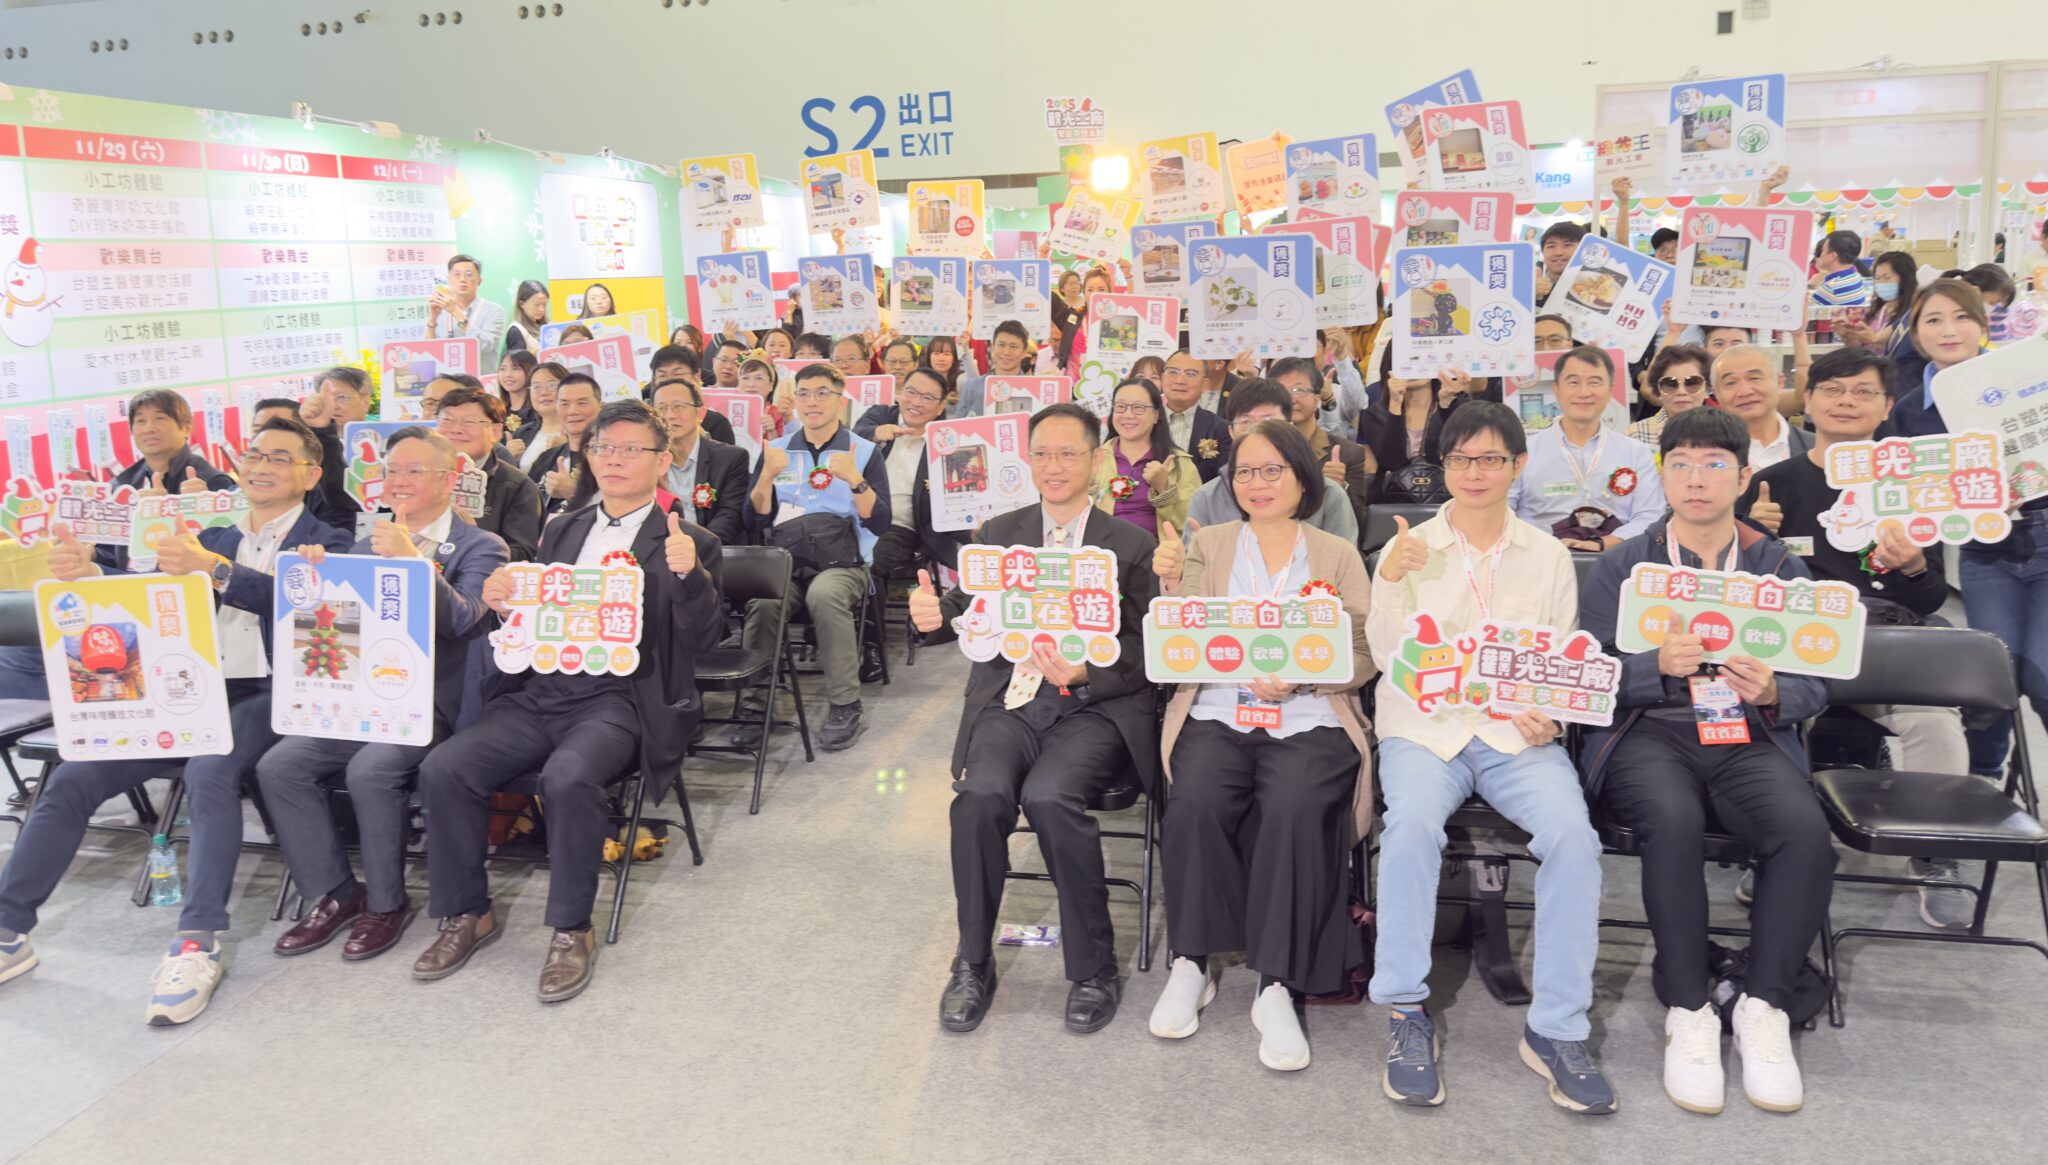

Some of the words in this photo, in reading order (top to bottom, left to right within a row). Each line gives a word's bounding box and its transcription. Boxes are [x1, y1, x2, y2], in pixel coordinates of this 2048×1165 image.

[800, 94, 890, 158] S2
[898, 90, 953, 125] 出口
[75, 137, 127, 159] 11/29
[132, 140, 165, 162] (六)
[900, 131, 954, 158] EXIT
[85, 170, 163, 190] 小工坊體驗
[1535, 171, 1571, 185] Kang
[98, 247, 163, 265] 歡樂舞台
[1488, 255, 1507, 289] 獲獎
[104, 319, 182, 342] 小工坊體驗
[1832, 436, 1997, 483] 觀光工廠
[61, 483, 107, 501] 2025
[1876, 471, 2001, 513] 自在遊
[60, 498, 130, 521] 觀光工
[964, 550, 1111, 591] 觀光工廠
[508, 566, 643, 605] 觀光工廠
[1638, 568, 1852, 618] 觀光工廠自在遊
[536, 603, 638, 642] 自在遊
[1001, 588, 1114, 631] 自在遊
[1155, 600, 1338, 628] 觀光工廠自在遊
[1482, 624, 1551, 653] 2025
[1693, 622, 1730, 641] 體驗
[1744, 628, 1782, 646] 歡樂
[1797, 635, 1835, 652] 美學
[1167, 646, 1195, 660] 教育
[1208, 646, 1241, 661] 體驗
[1253, 646, 1285, 661] 歡樂
[1299, 646, 1329, 660] 美學
[1478, 645, 1616, 693] 觀光工廠
[1497, 680, 1611, 713] 聖誕夢想派對
[1238, 709, 1279, 725] 貴賓證
[1702, 725, 1746, 741] 貴賓證
